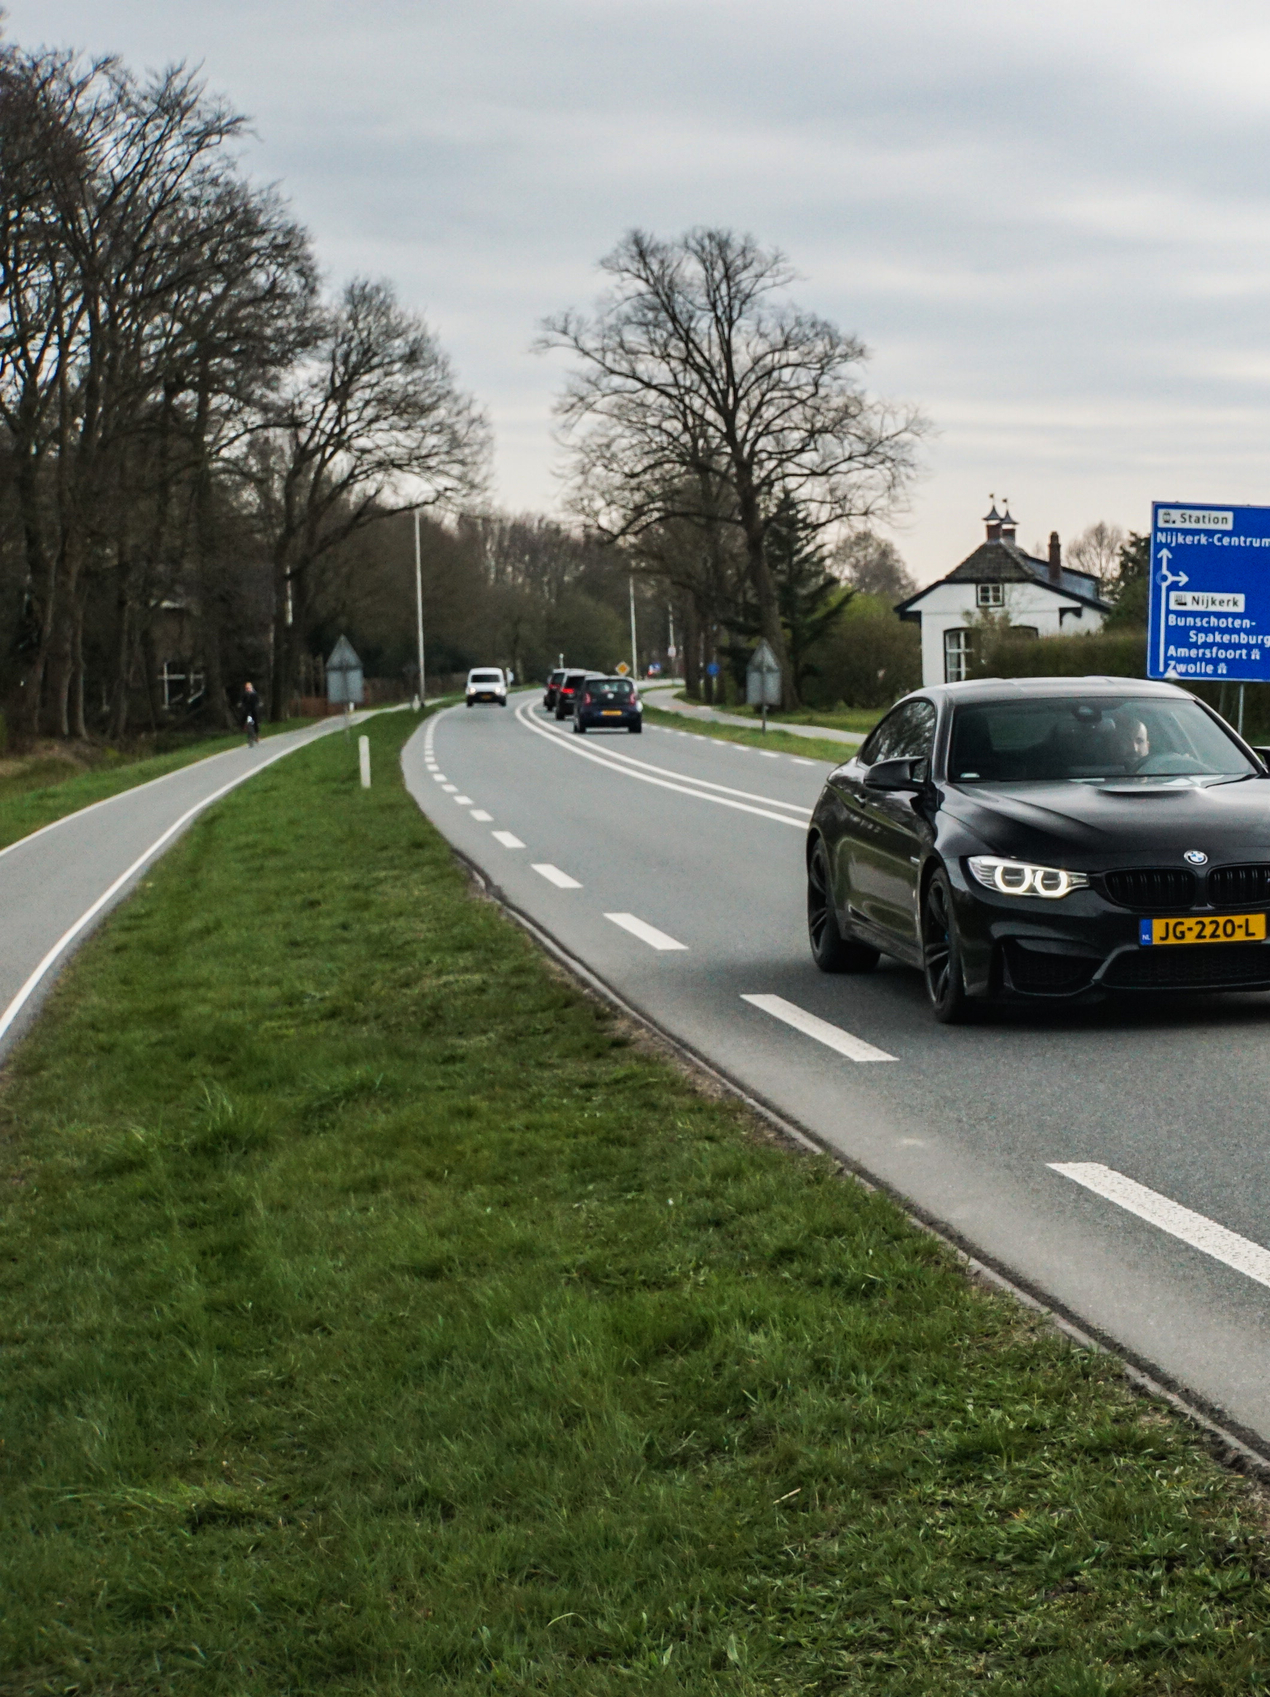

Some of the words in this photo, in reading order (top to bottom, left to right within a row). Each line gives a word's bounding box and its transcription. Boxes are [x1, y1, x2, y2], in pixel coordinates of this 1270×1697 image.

[1179, 512, 1229, 525] Station
[1191, 596, 1239, 609] Nijkerk
[1168, 614, 1256, 629] Bunschoten-
[1167, 645, 1248, 660] Amersfoort
[1167, 660, 1215, 674] Zwolle
[1159, 918, 1256, 941] JG-220-L
